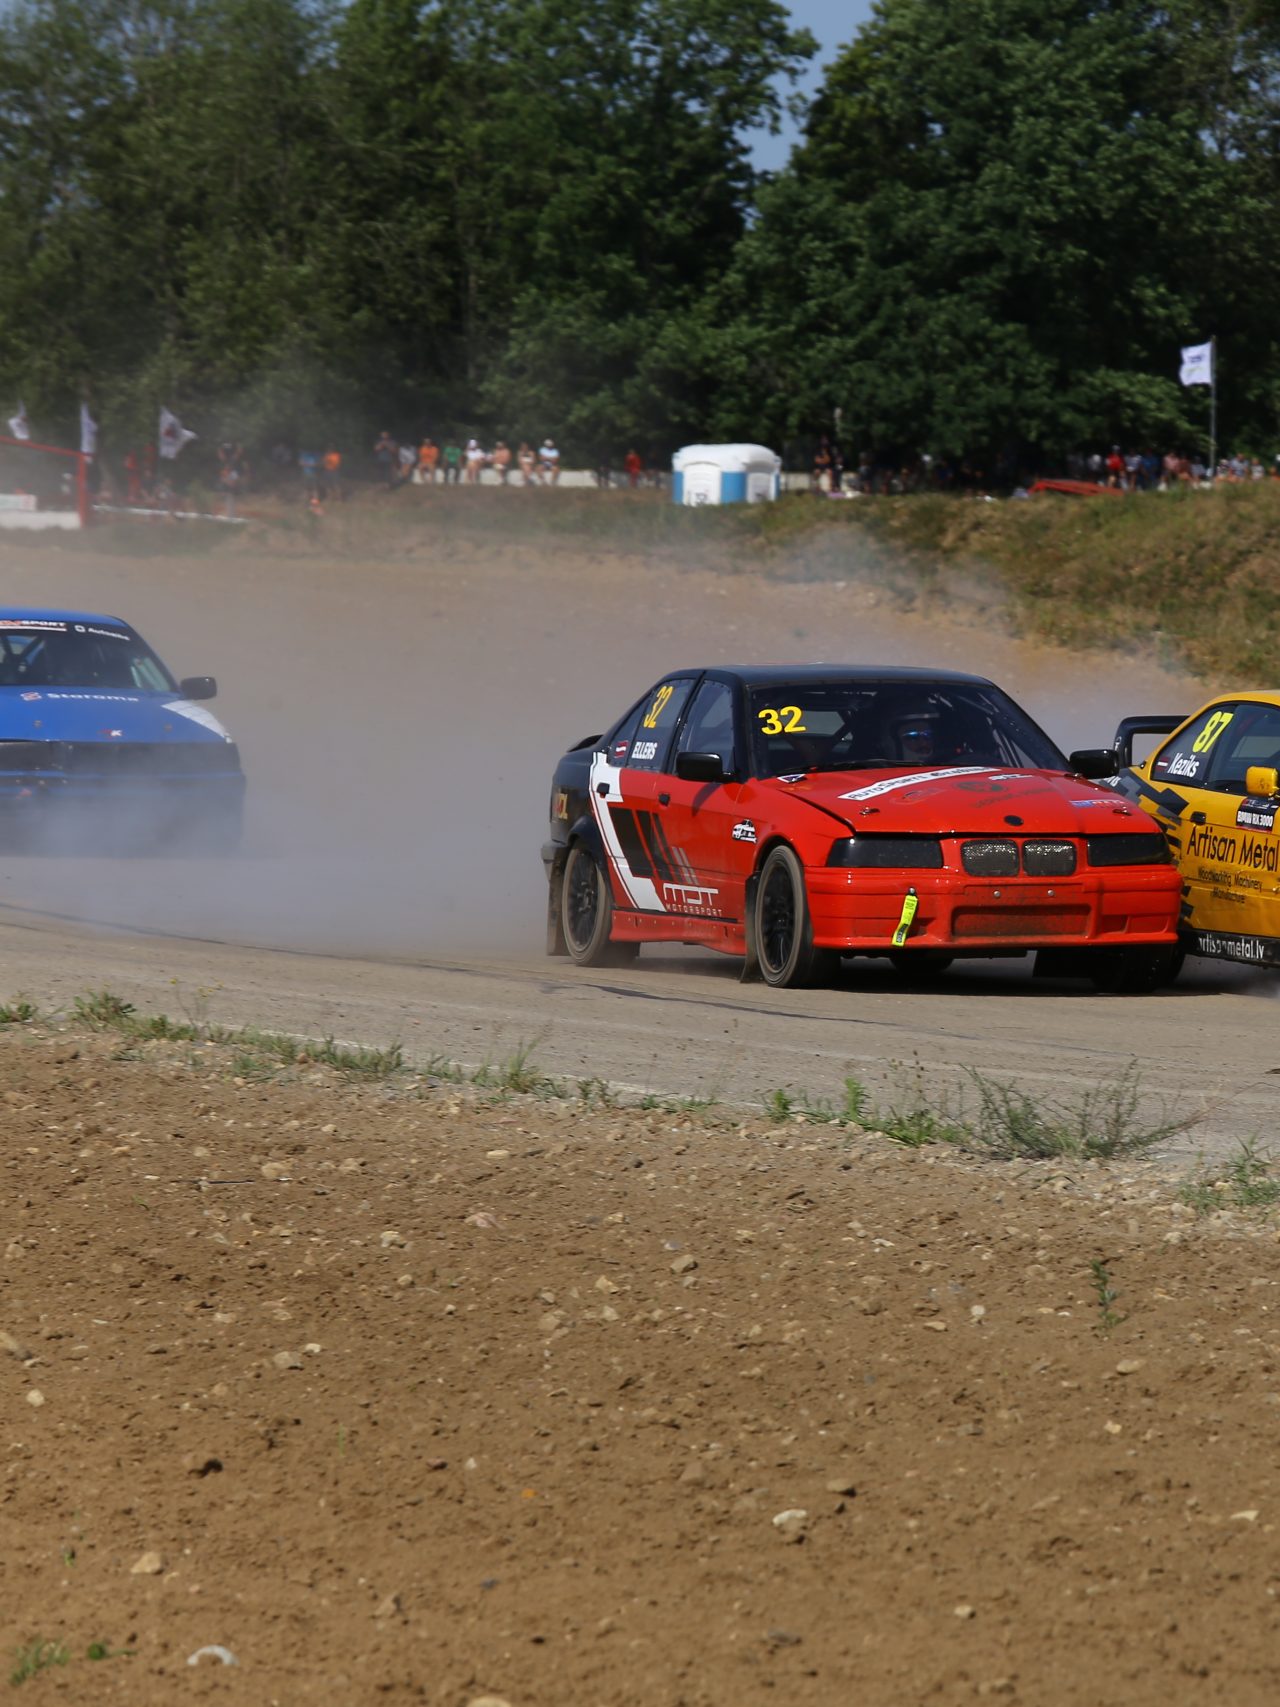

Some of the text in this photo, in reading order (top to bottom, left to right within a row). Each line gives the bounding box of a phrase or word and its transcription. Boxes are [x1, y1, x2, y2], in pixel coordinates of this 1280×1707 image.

[643, 685, 675, 729] 32
[758, 705, 807, 735] 32
[1192, 710, 1234, 753] 87
[632, 741, 658, 760] ELLERS
[1187, 825, 1280, 873] Artisan Metal
[665, 903, 722, 917] MOTORSPORT
